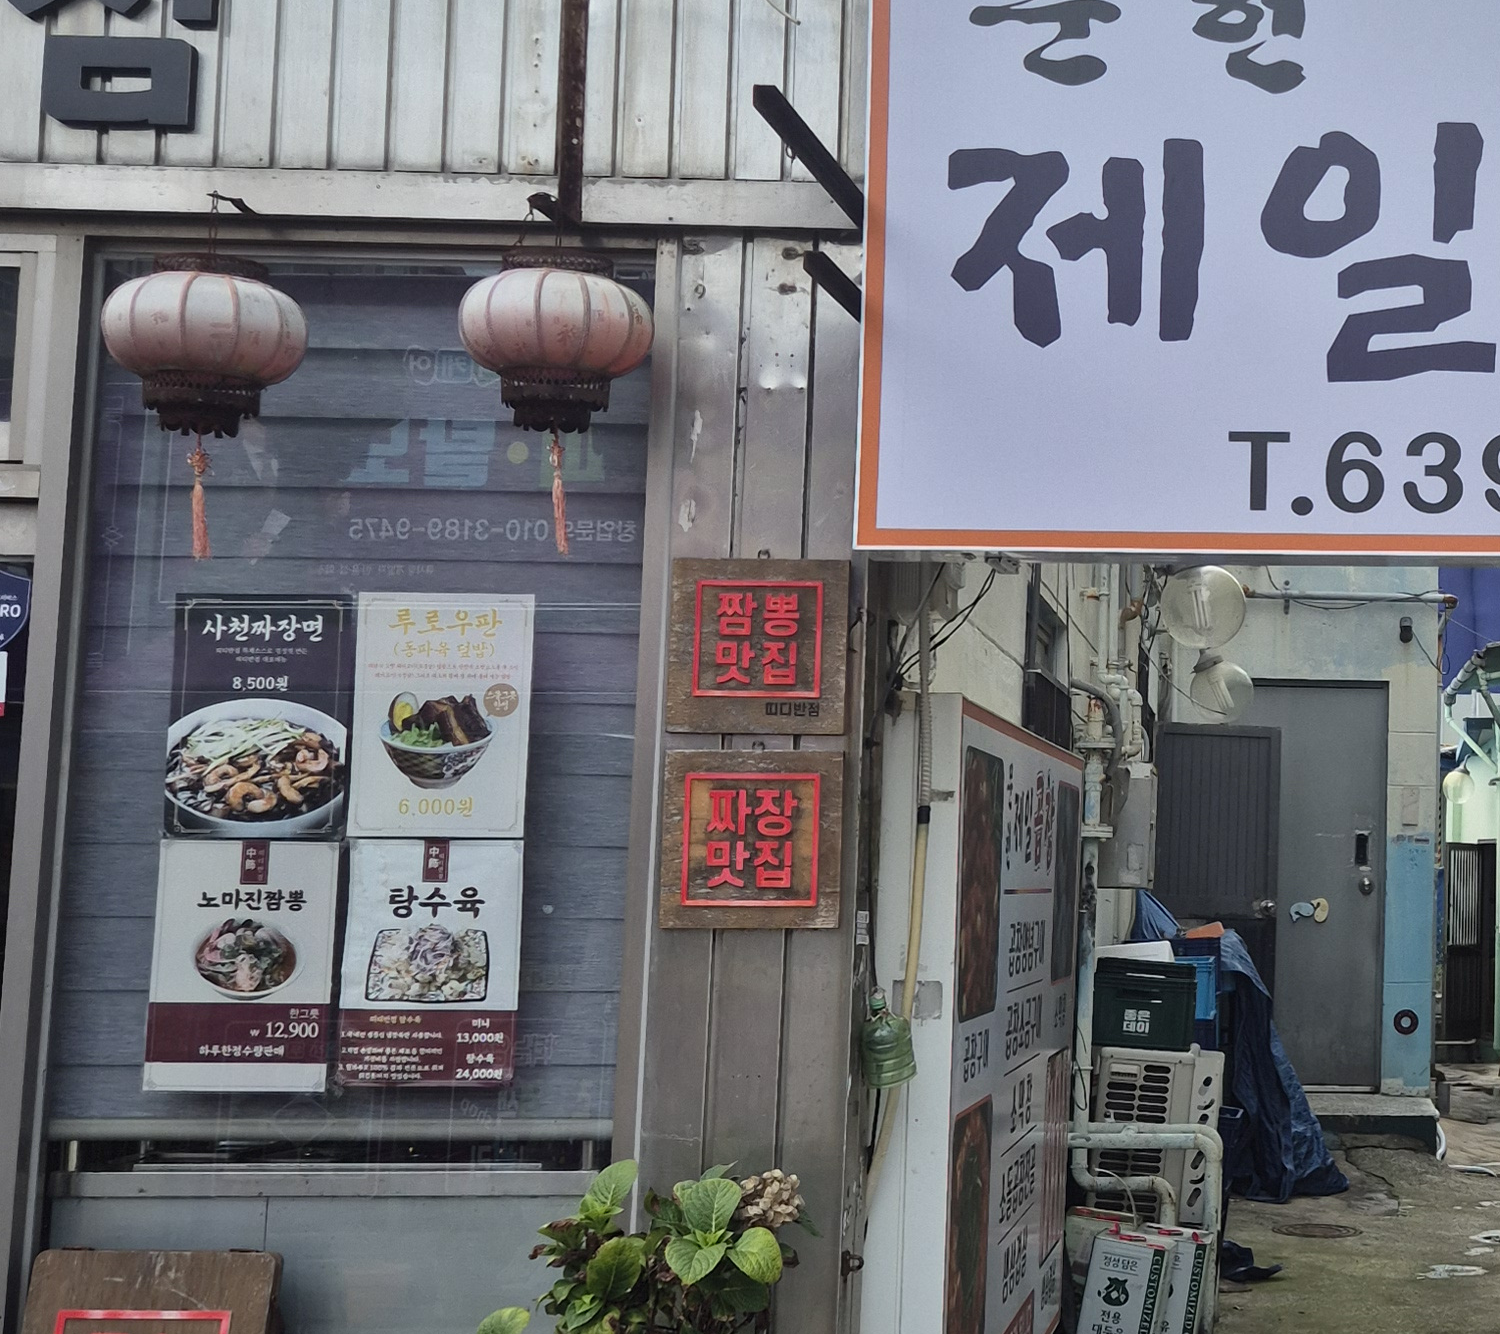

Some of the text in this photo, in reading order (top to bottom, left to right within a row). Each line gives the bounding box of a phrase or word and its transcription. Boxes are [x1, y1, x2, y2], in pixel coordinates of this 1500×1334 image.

[202, 613, 325, 643] 사천짜장면
[715, 592, 801, 637] 짬뽕
[714, 640, 798, 685] 맛집
[231, 674, 289, 692] 8,500원
[765, 702, 821, 718] 띠디반점
[706, 788, 798, 838] 짜장
[706, 840, 794, 889] 맛집
[196, 888, 308, 913] 노마진짬뽕
[388, 885, 486, 920] 탕수육
[264, 1021, 320, 1040] 12,900
[471, 1018, 490, 1029] 미니
[456, 1032, 504, 1045] 13,000원
[455, 1068, 503, 1081] 24,000원
[1184, 1250, 1204, 1331] CUSTOMIZED
